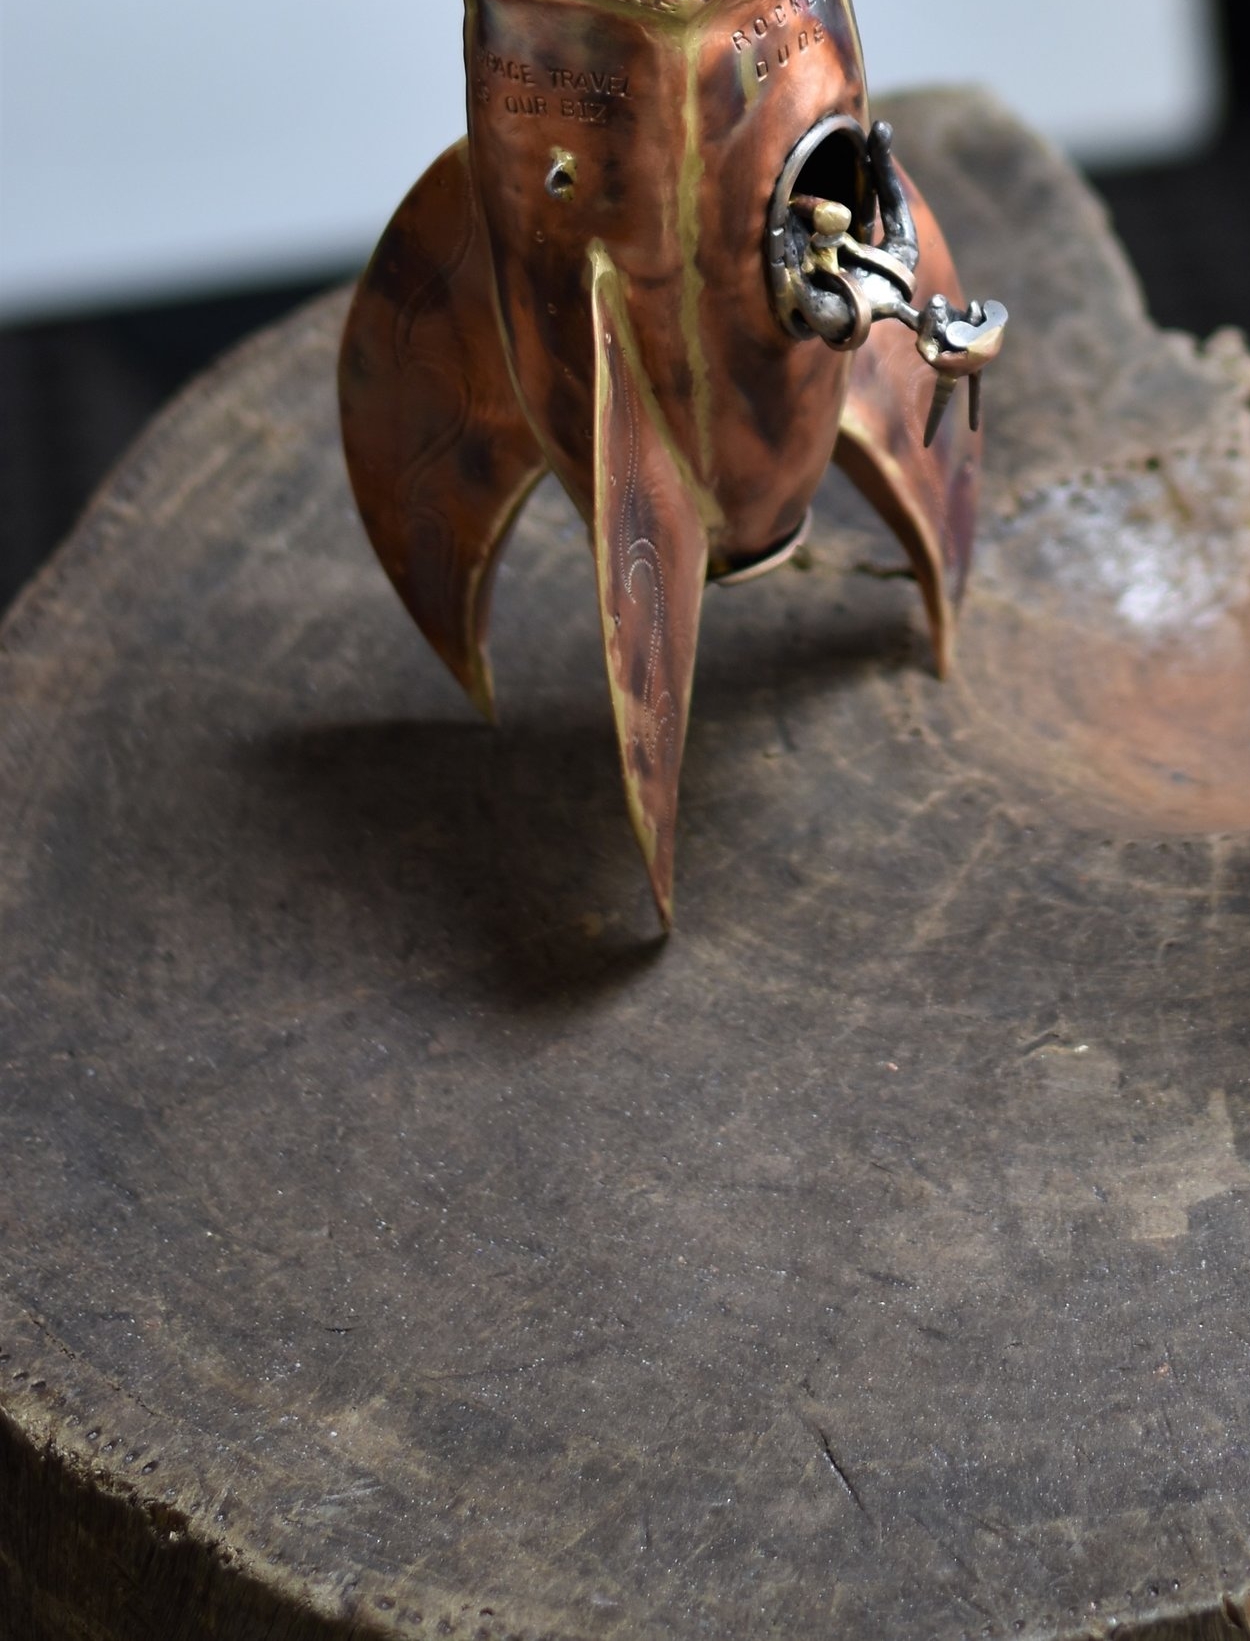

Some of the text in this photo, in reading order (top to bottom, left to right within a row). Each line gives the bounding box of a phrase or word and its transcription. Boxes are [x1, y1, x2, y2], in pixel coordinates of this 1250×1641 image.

[755, 22, 825, 83] DUDE
[549, 67, 633, 100] TRAVEL
[504, 95, 549, 119] OUR
[560, 98, 608, 125] BIZ
